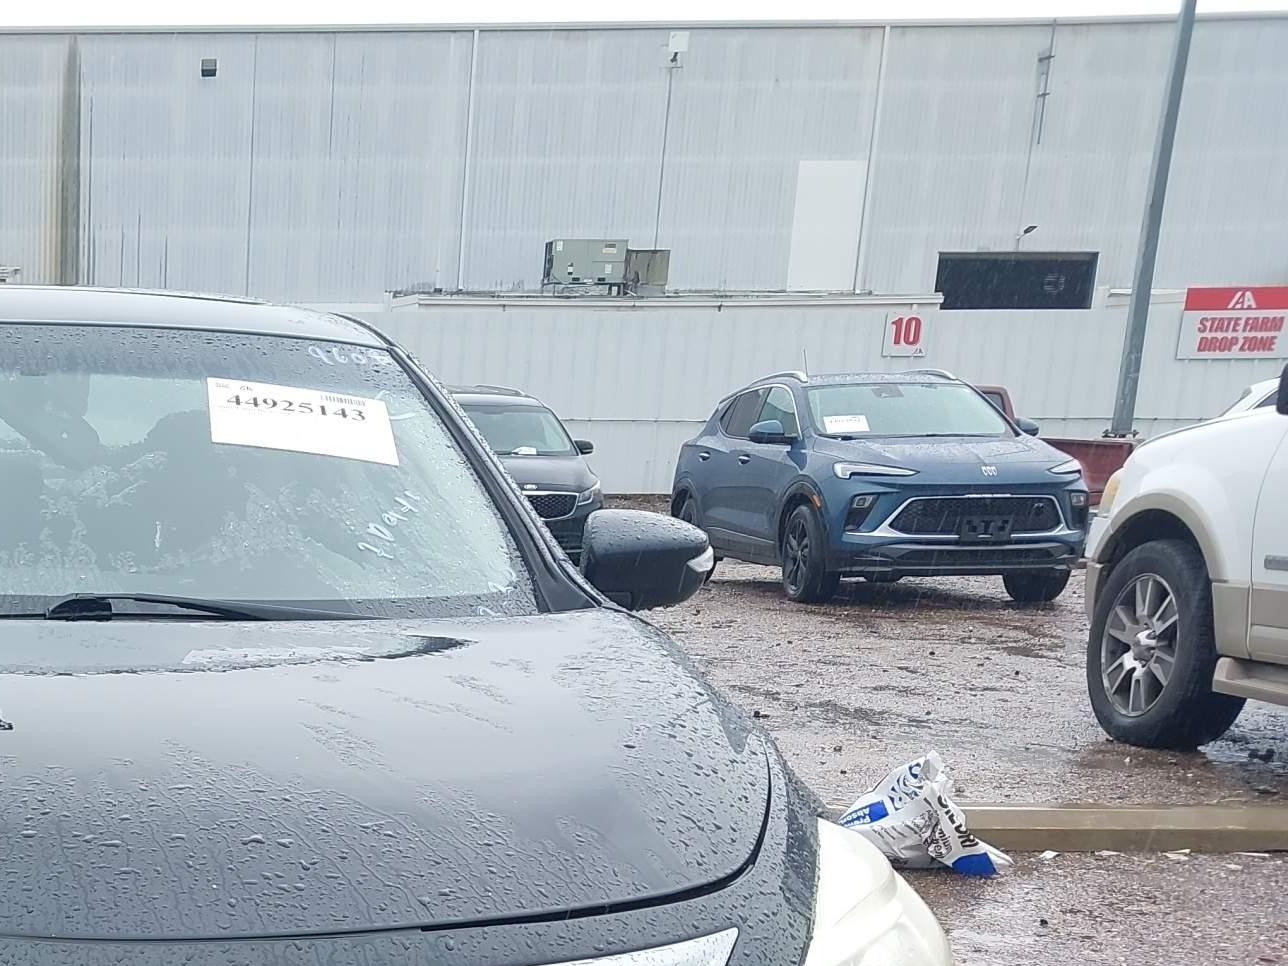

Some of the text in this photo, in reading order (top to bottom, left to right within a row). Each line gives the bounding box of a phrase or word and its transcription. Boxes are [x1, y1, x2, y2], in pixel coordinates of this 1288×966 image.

[891, 316, 921, 345] 10
[1197, 316, 1285, 333] STATE FARM
[1197, 335, 1278, 352] DROP ZONE
[226, 394, 366, 422] 44925143
